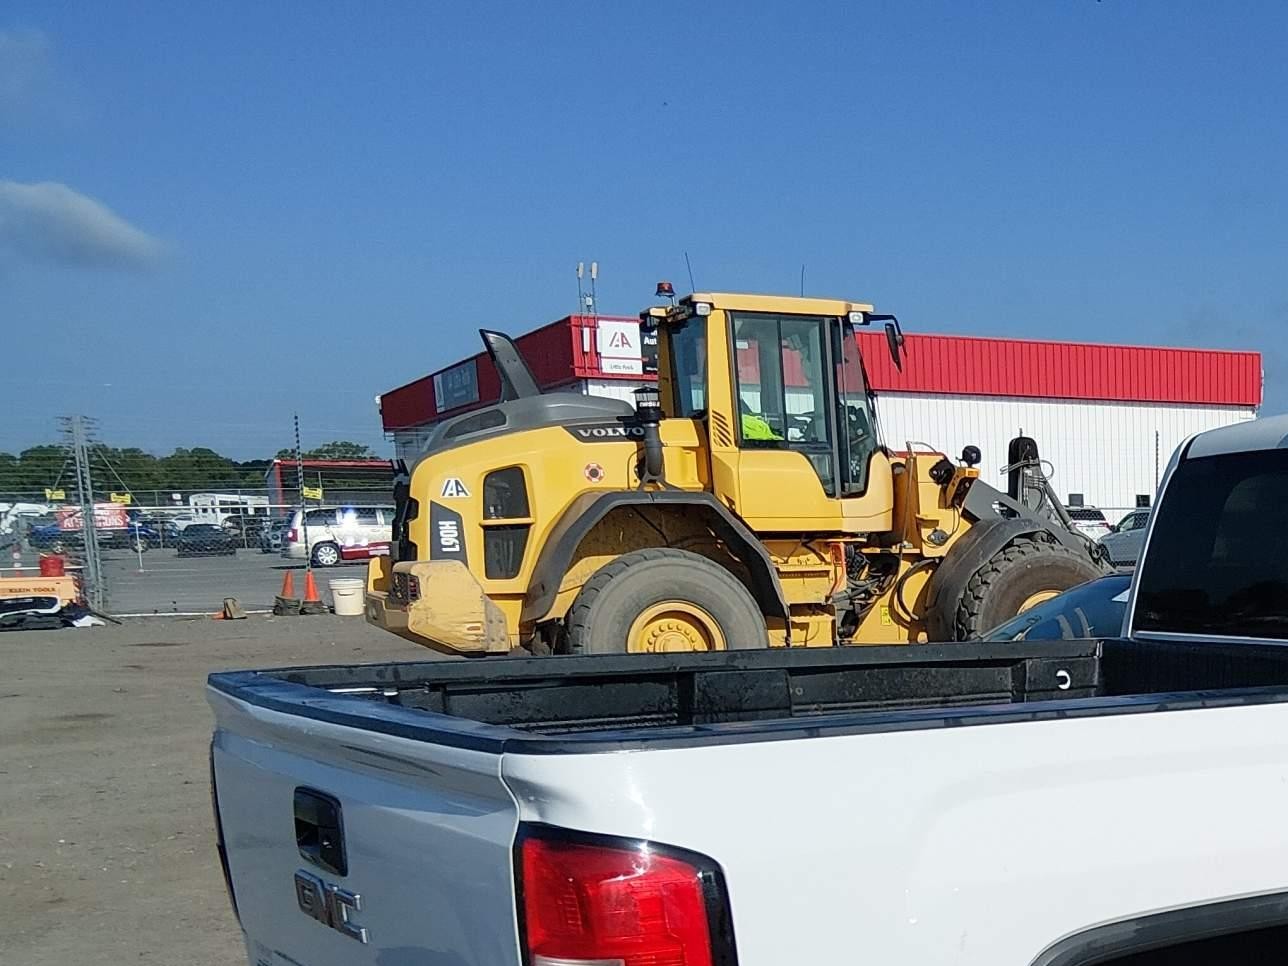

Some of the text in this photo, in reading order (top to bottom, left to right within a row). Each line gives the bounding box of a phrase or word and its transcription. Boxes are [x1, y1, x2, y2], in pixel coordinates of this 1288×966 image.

[577, 426, 645, 437] VOLVO
[438, 520, 460, 552] L90H
[294, 868, 368, 944] GMC
